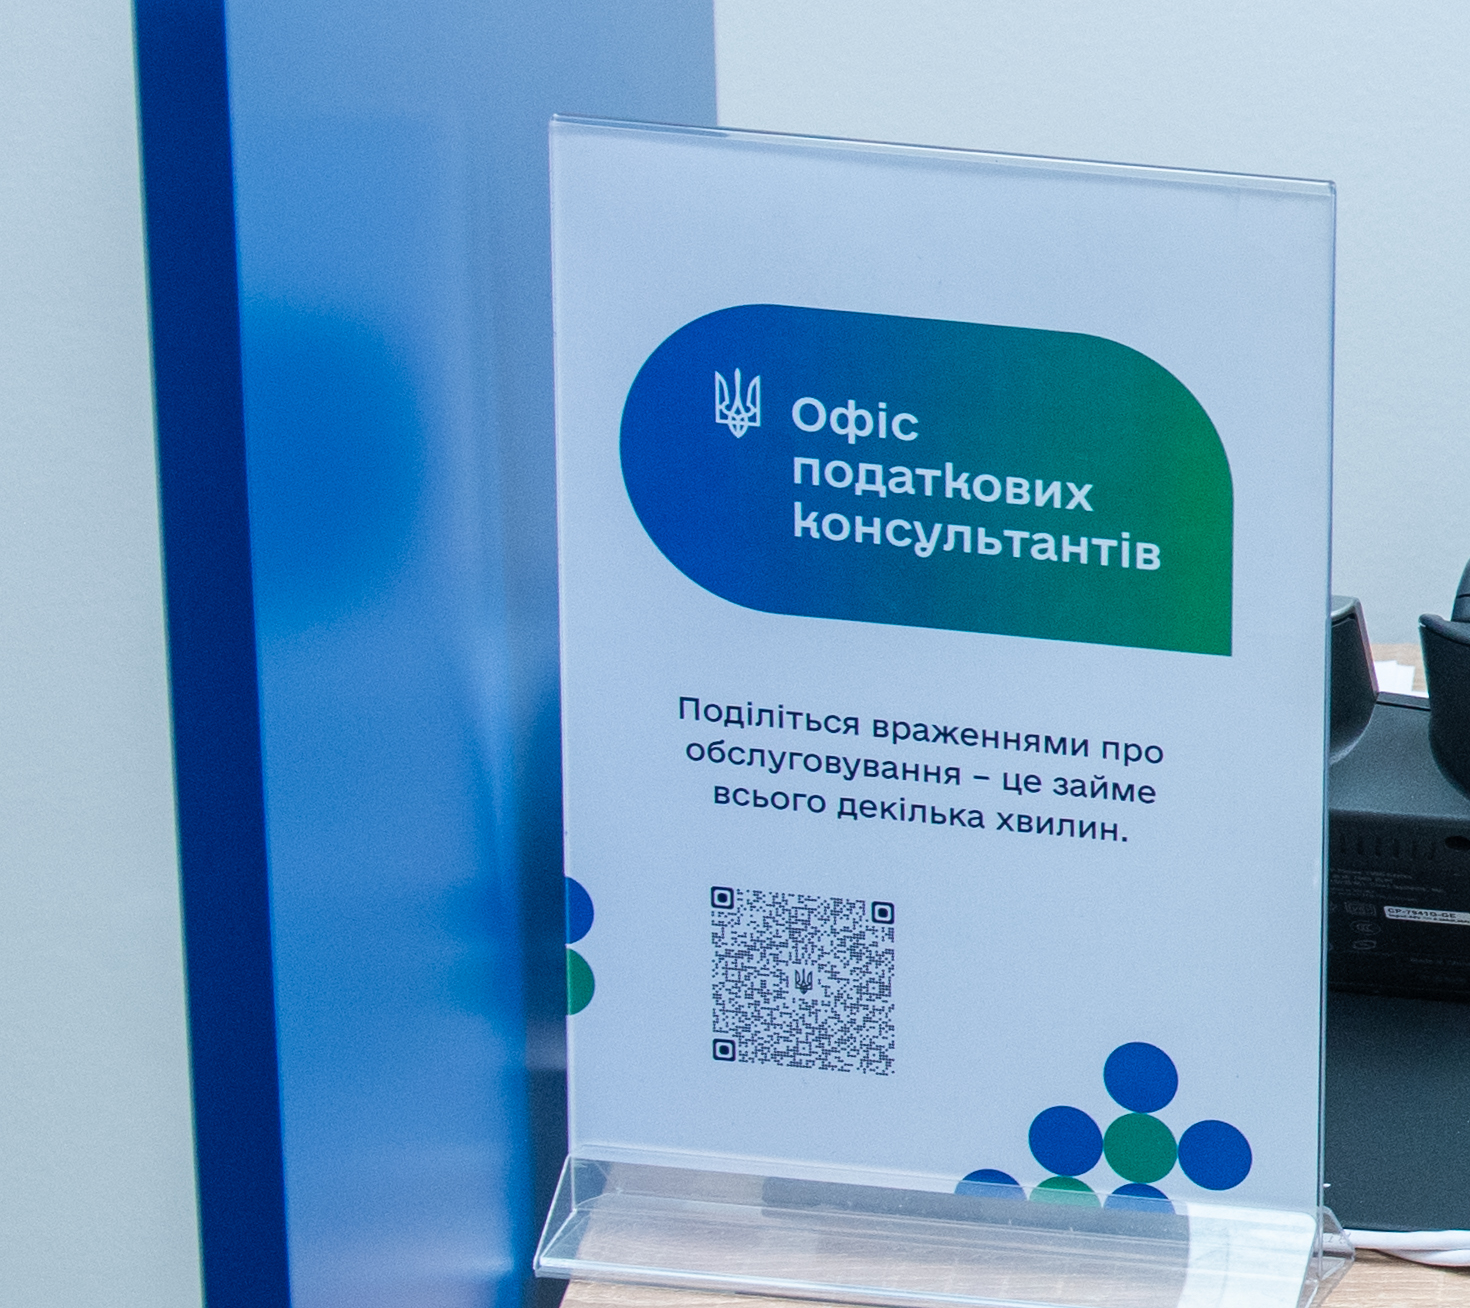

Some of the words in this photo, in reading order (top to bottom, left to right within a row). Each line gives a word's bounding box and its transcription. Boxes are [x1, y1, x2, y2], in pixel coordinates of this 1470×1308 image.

[791, 395, 920, 445] Офіс
[793, 456, 1095, 512] податкових
[793, 500, 1162, 571] консультантів
[678, 695, 860, 736] Поділіться
[872, 718, 1089, 758] враженнями
[1101, 740, 1165, 767] про
[685, 738, 961, 786] обслуговування
[1002, 771, 1043, 796] це
[1052, 774, 1157, 805] займе
[713, 785, 827, 814] всього
[836, 795, 986, 830] декілька
[995, 811, 1129, 843] хвилин.
